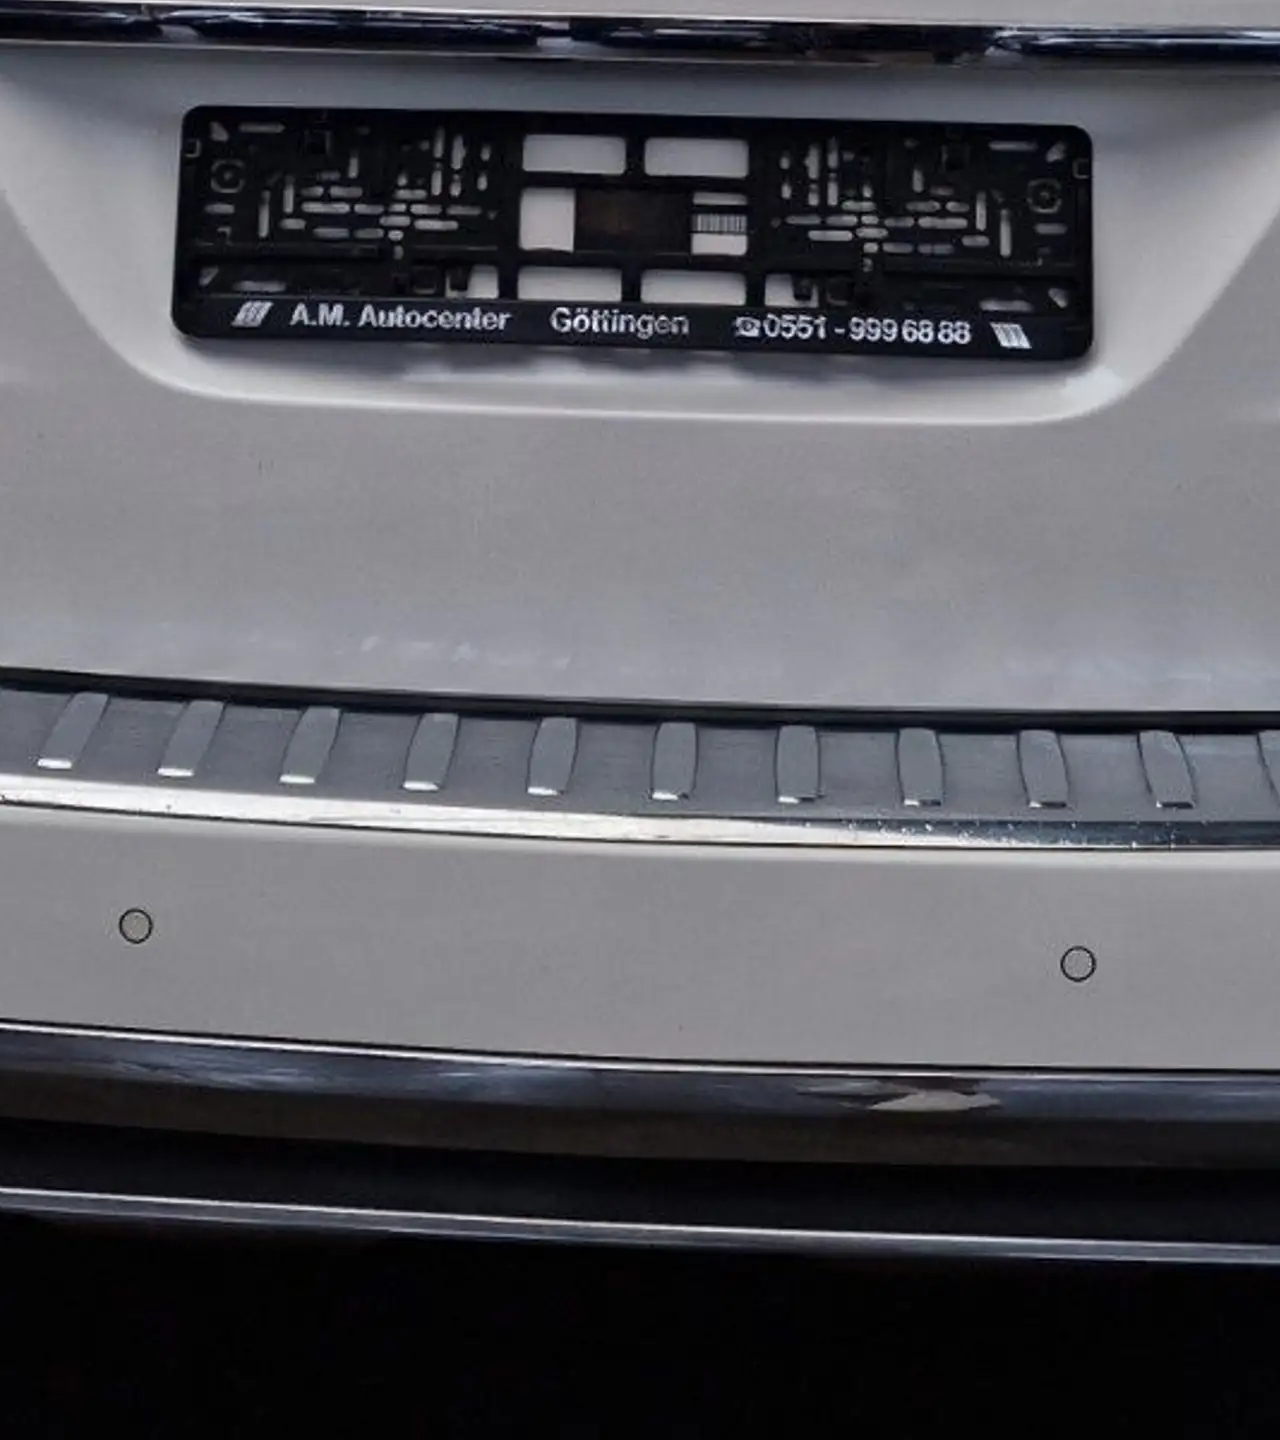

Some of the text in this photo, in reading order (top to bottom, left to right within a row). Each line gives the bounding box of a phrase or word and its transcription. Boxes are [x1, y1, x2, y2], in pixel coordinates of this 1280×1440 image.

[290, 302, 350, 328] A.M.
[358, 305, 513, 332] Autocenter
[549, 306, 690, 339] Göttingen
